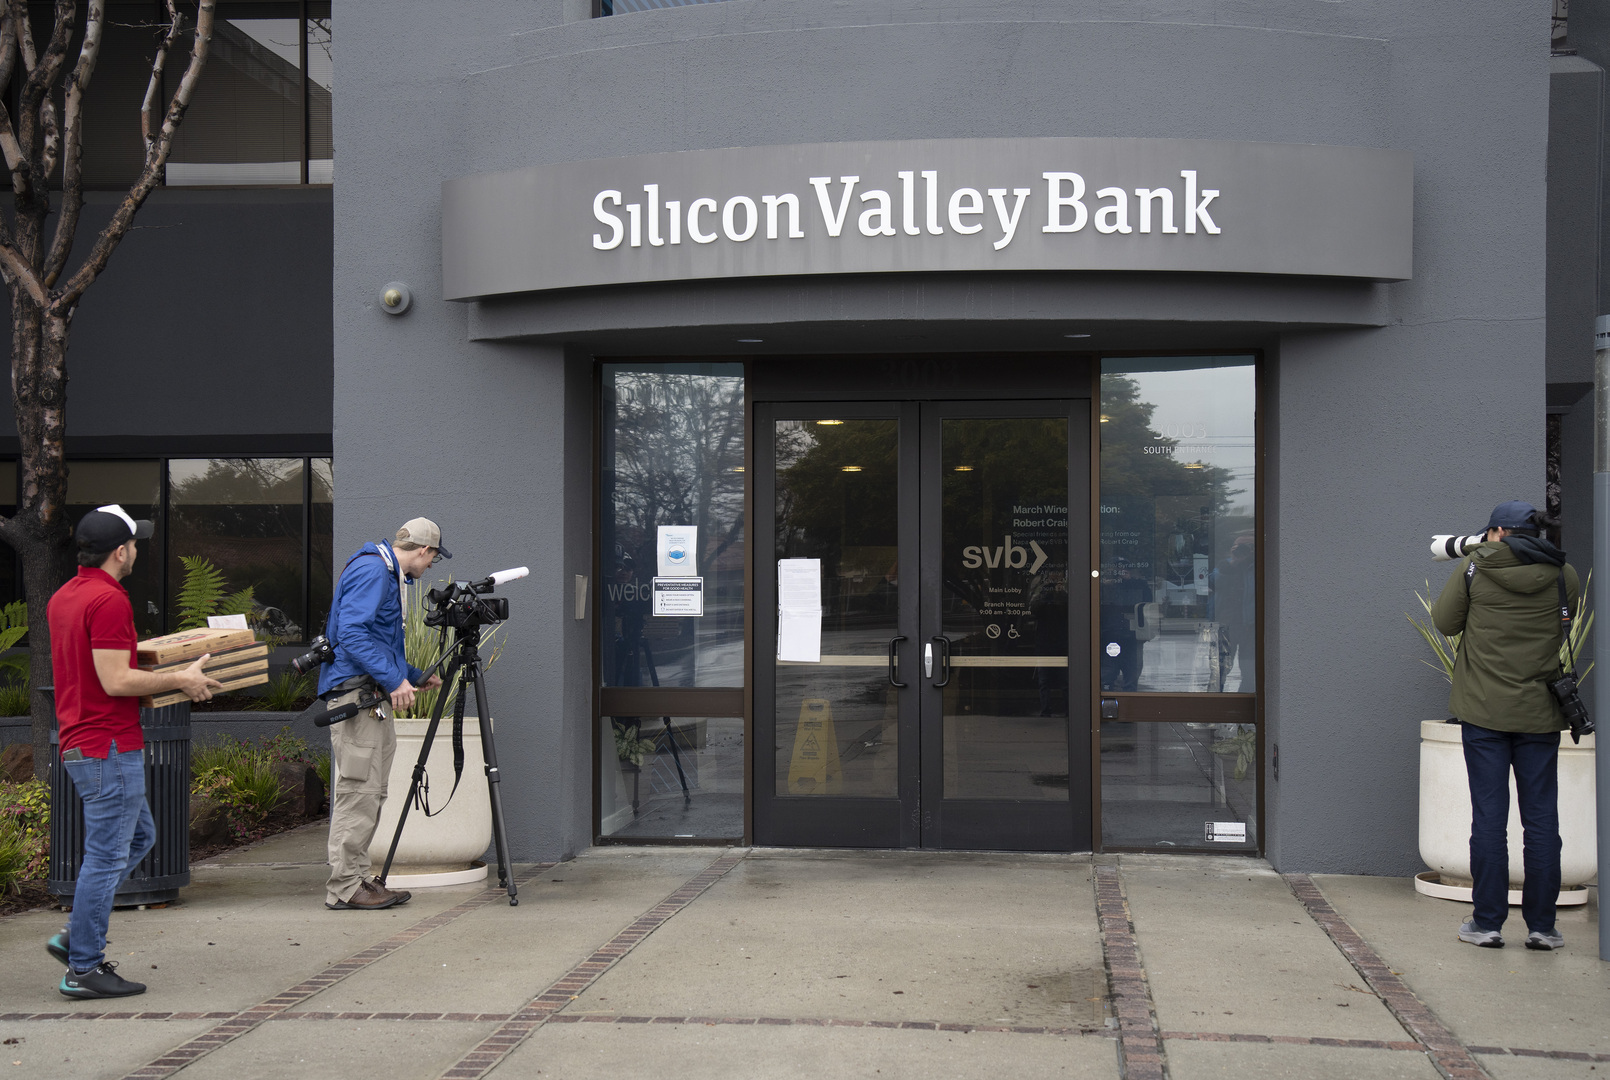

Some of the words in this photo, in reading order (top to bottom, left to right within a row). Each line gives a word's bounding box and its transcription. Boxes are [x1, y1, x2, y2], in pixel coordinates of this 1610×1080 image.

[809, 171, 1030, 251] Valley
[1042, 170, 1221, 235] Bank
[1143, 446, 1171, 455] SOUTH
[1013, 505, 1043, 514] March
[1044, 505, 1068, 514] Wine
[1100, 504, 1121, 514] tion:
[1013, 518, 1045, 527] Robert
[962, 535, 1028, 569] svb
[1467, 562, 1476, 577] ONY
[608, 578, 653, 602] welc
